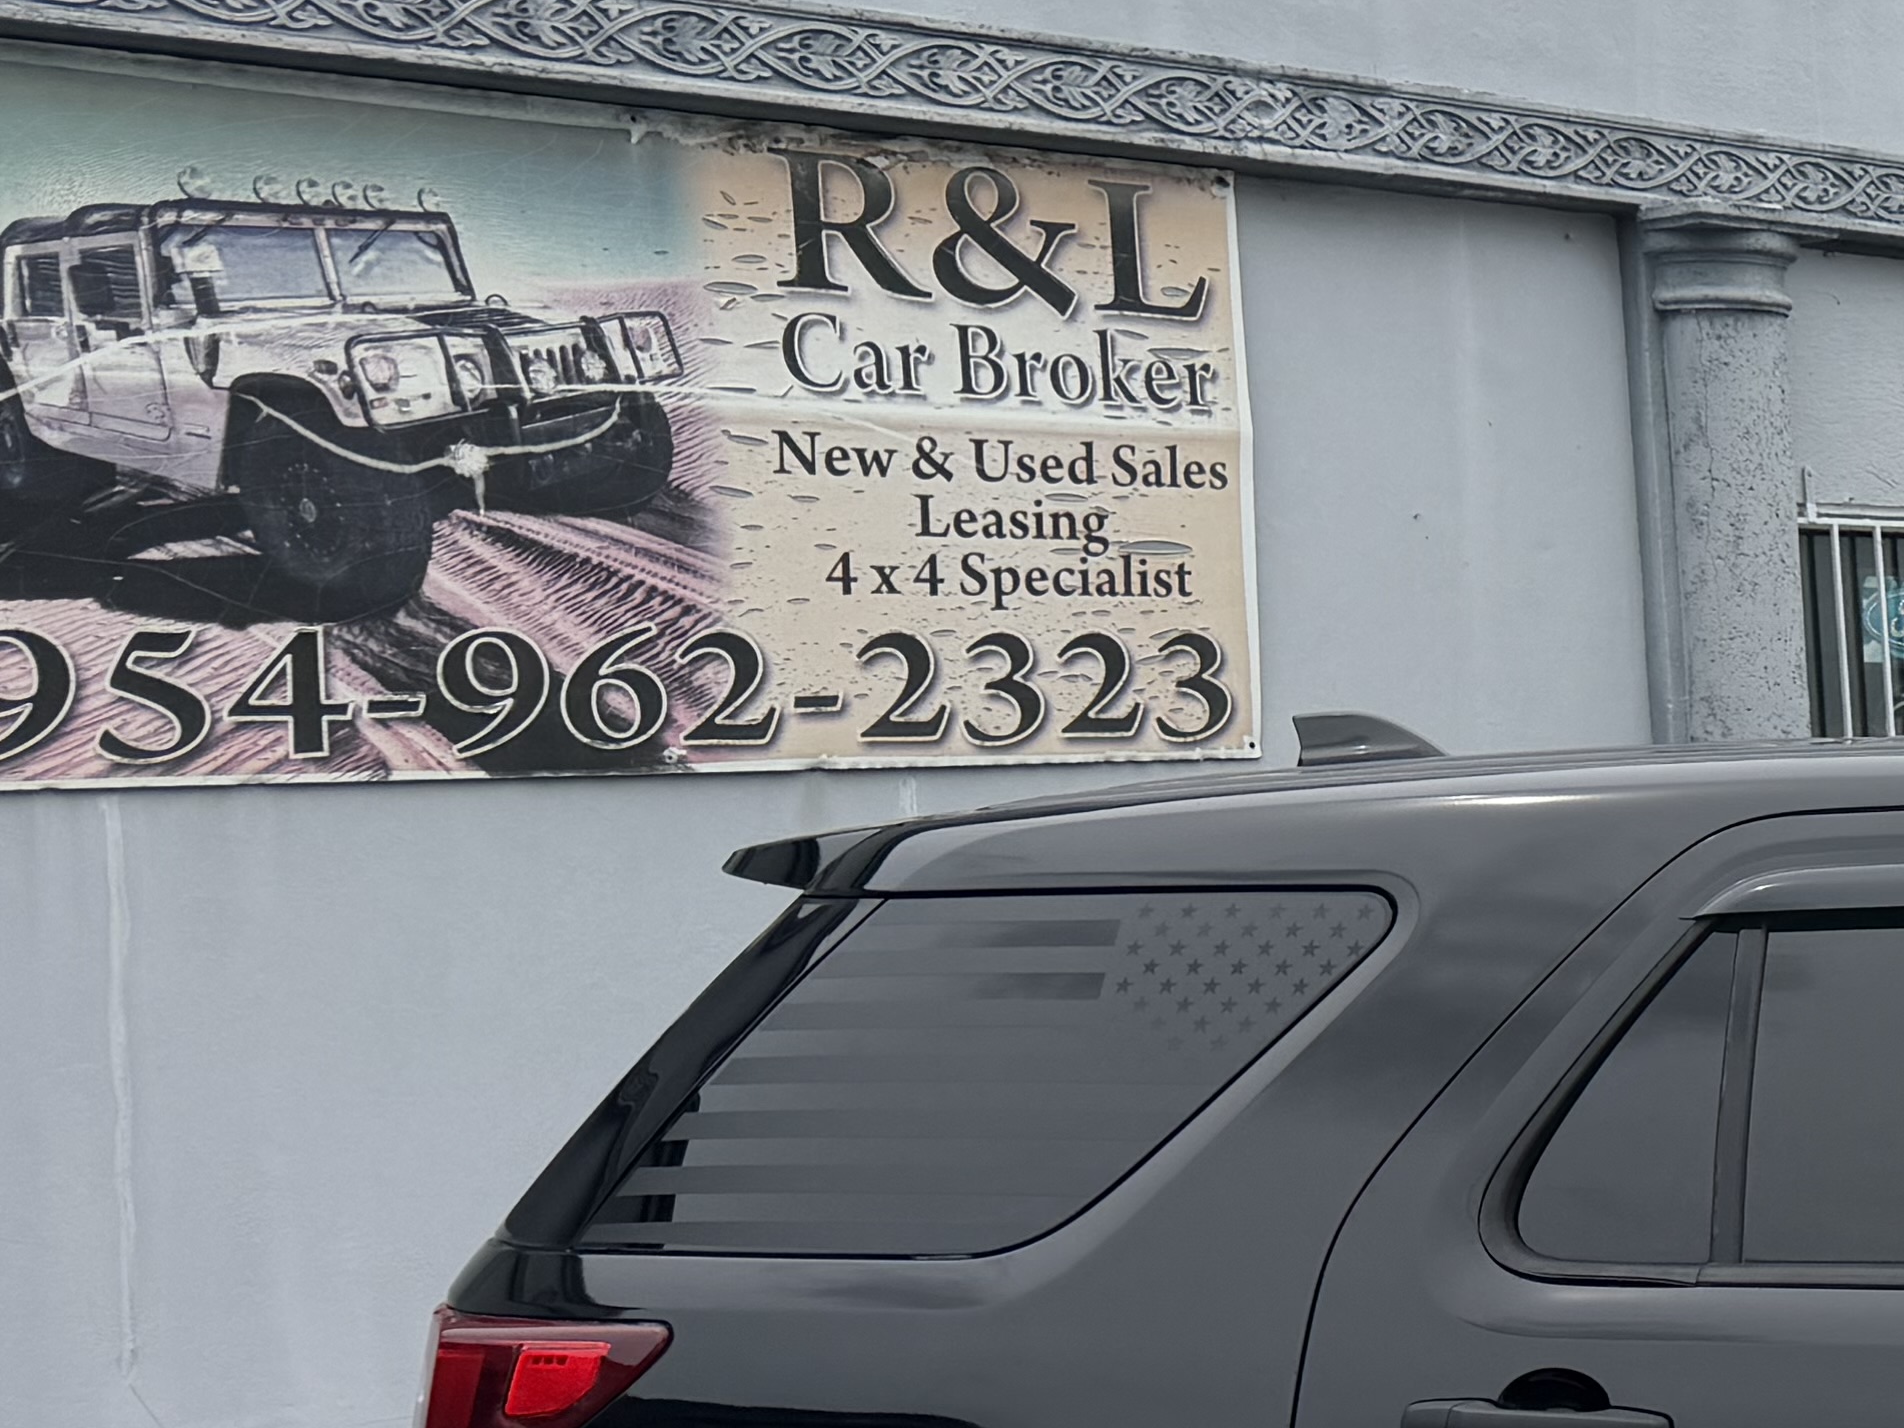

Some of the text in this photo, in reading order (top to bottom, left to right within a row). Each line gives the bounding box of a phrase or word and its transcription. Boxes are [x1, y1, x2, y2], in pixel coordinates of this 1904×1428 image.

[766, 146, 1209, 322] R&L
[781, 310, 1216, 413] Car Broker
[772, 429, 1228, 490] New & Used Sales
[914, 494, 1110, 557] Leasing
[826, 550, 1193, 611] 4 x 4 Specialist
[0, 622, 1233, 765] 954-962-2323
